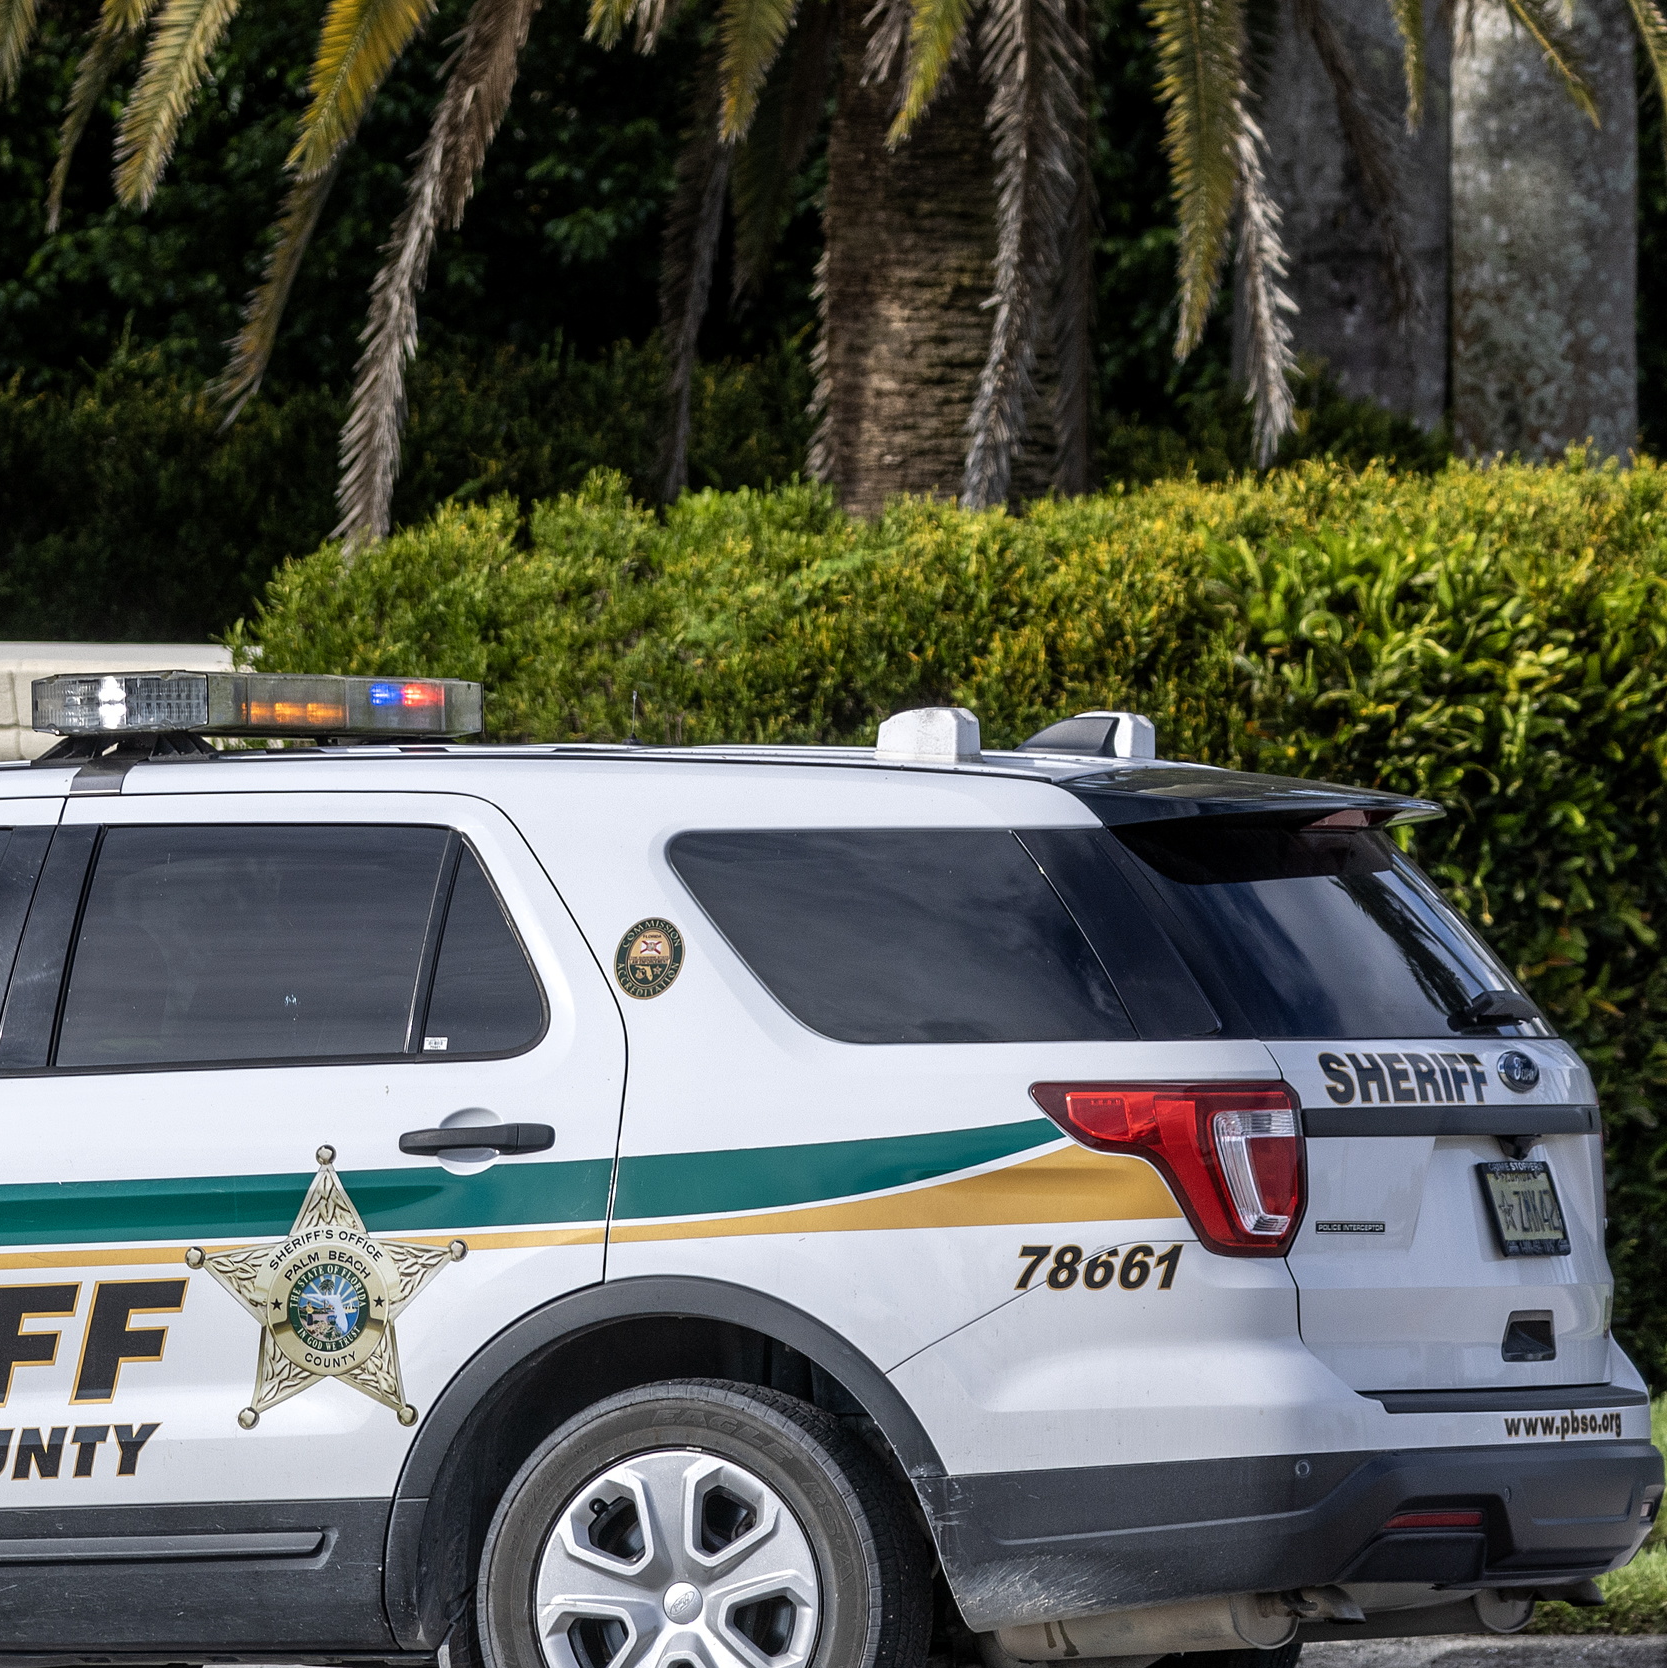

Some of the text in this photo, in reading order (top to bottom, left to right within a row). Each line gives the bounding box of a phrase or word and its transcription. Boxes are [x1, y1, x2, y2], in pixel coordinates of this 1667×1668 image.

[622, 920, 681, 948] COMMISSION
[617, 962, 679, 997] ACCREDITATION
[1318, 1052, 1488, 1105] SHERIFF
[269, 1230, 383, 1271] SHERIFF'S OFFICE
[284, 1250, 371, 1281] PALM BEACH
[1014, 1244, 1184, 1291] 78661
[289, 1264, 367, 1308] THE STATE OF FLORIDA
[297, 1325, 361, 1351] IN GOD WE TRUST
[304, 1351, 356, 1368] COUNTY
[651, 1409, 794, 1464] EAGLE
[1504, 1409, 1622, 1441] www.pbso.org
